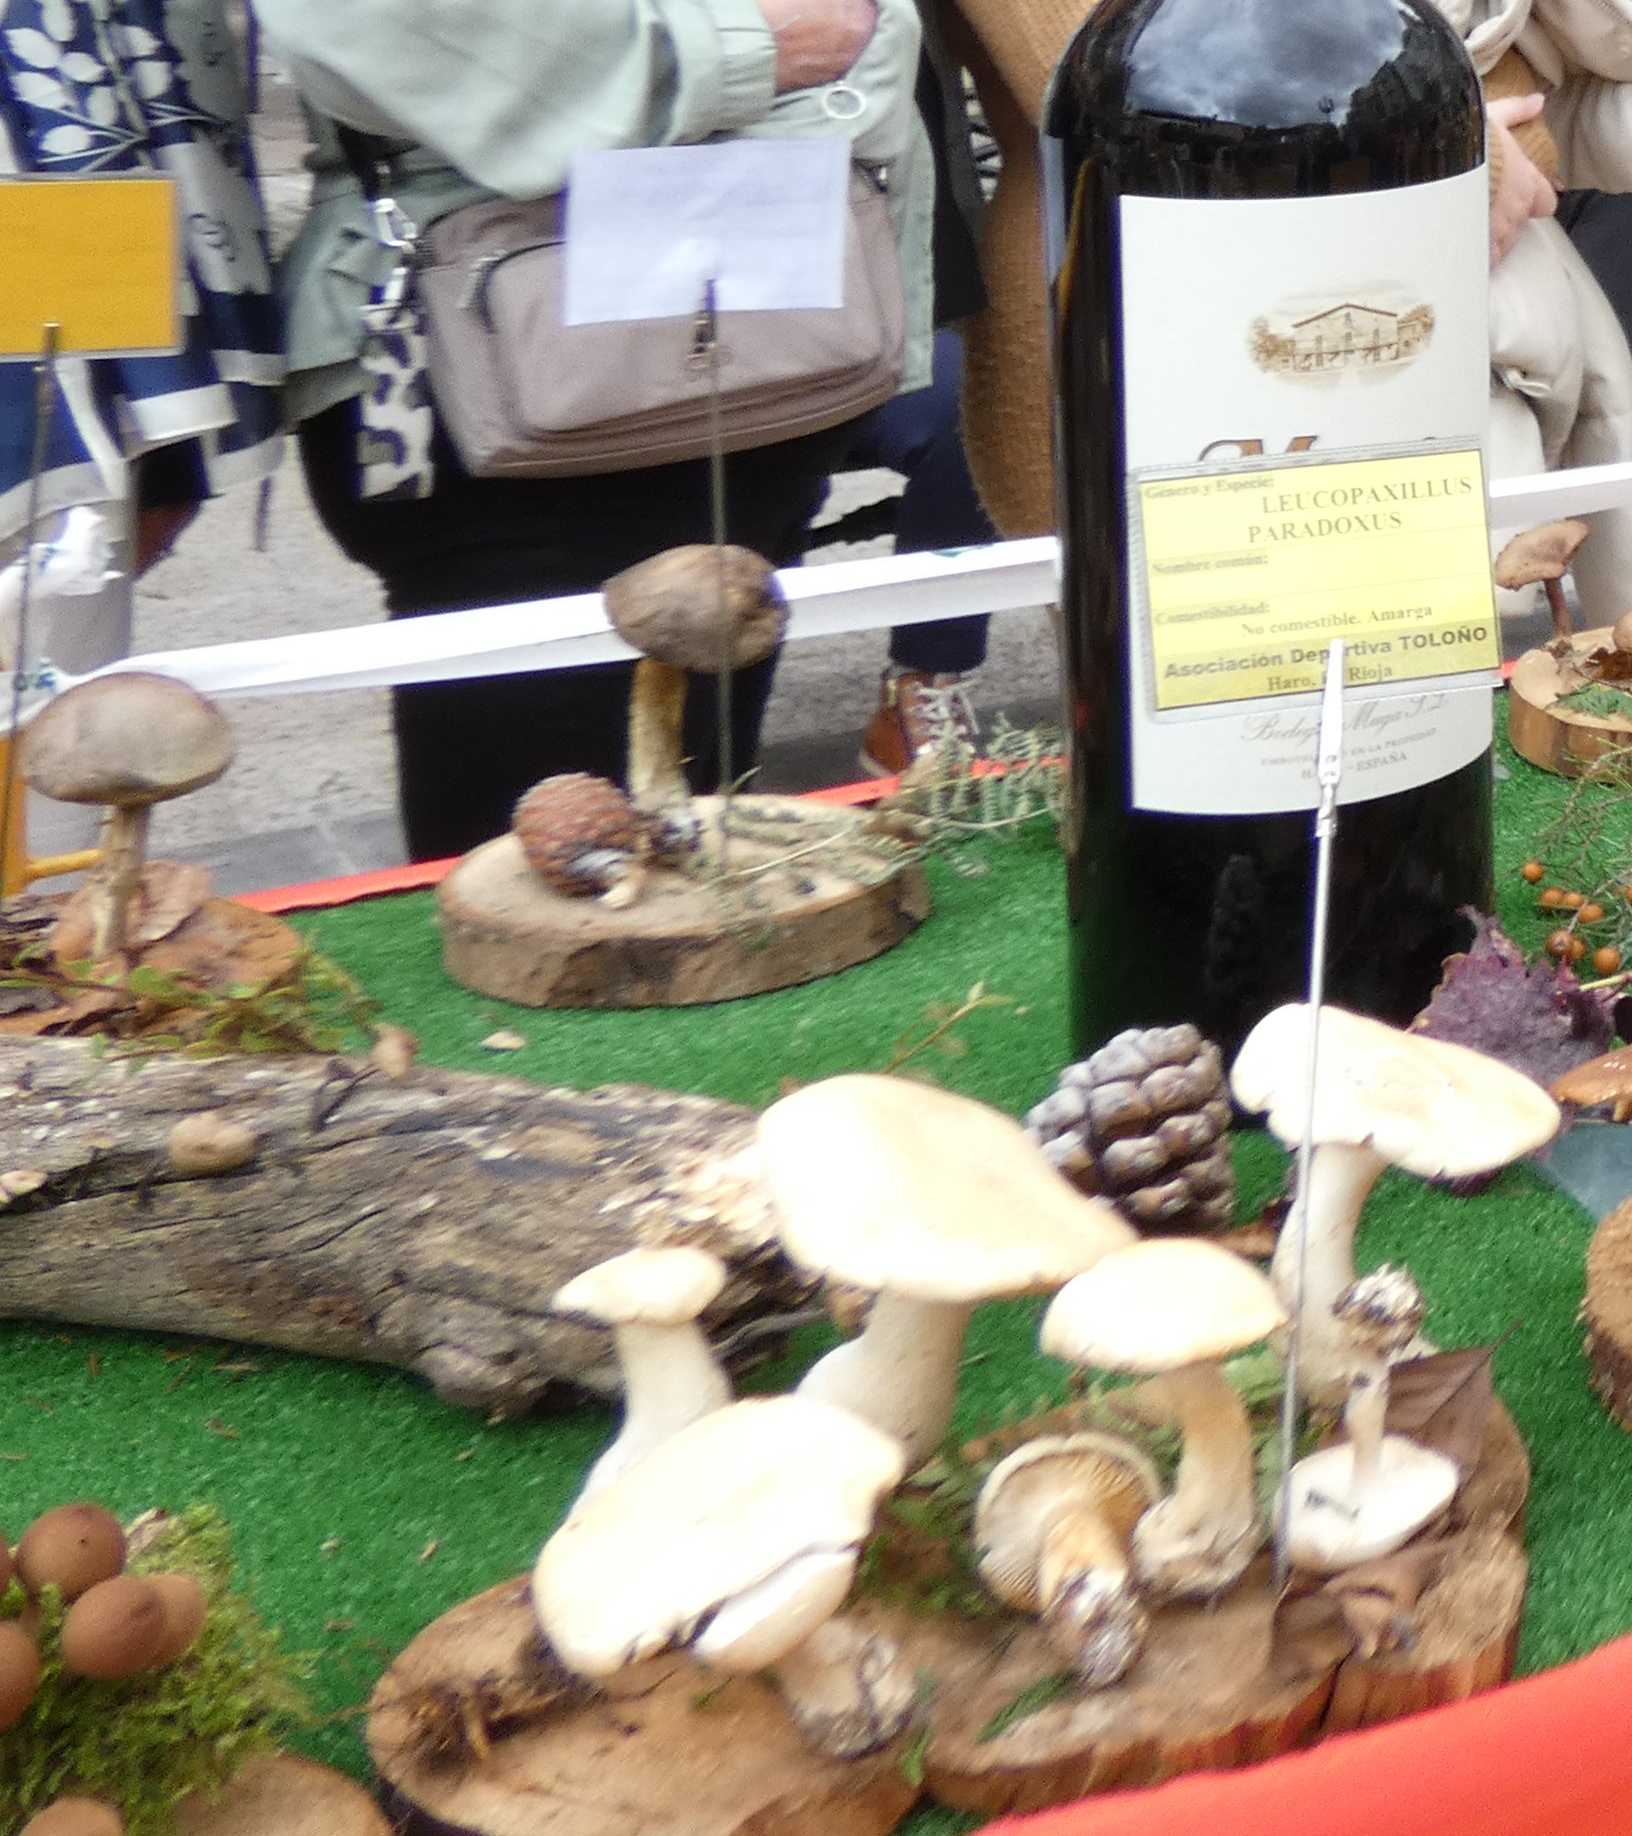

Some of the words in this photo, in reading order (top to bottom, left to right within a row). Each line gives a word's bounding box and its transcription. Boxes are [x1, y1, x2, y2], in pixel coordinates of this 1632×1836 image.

[1144, 482, 1201, 501] Género
[1215, 475, 1275, 494] Especie:
[1262, 476, 1473, 514] LEUCOPAXILLUS
[1247, 511, 1402, 544] PARADOXUS
[1152, 559, 1212, 575] Nombre
[1215, 551, 1269, 568] común:
[1155, 601, 1270, 626] Comestibilidad:
[1241, 620, 1265, 637] No
[1269, 612, 1362, 635] comestible.
[1367, 604, 1433, 625] Amarga
[1164, 651, 1283, 679] Asociación
[1291, 641, 1393, 667] Deprtiva
[1398, 626, 1488, 651] TOLOÑO
[1348, 664, 1393, 683] Rioja
[1356, 750, 1409, 772] ESPAÑA
